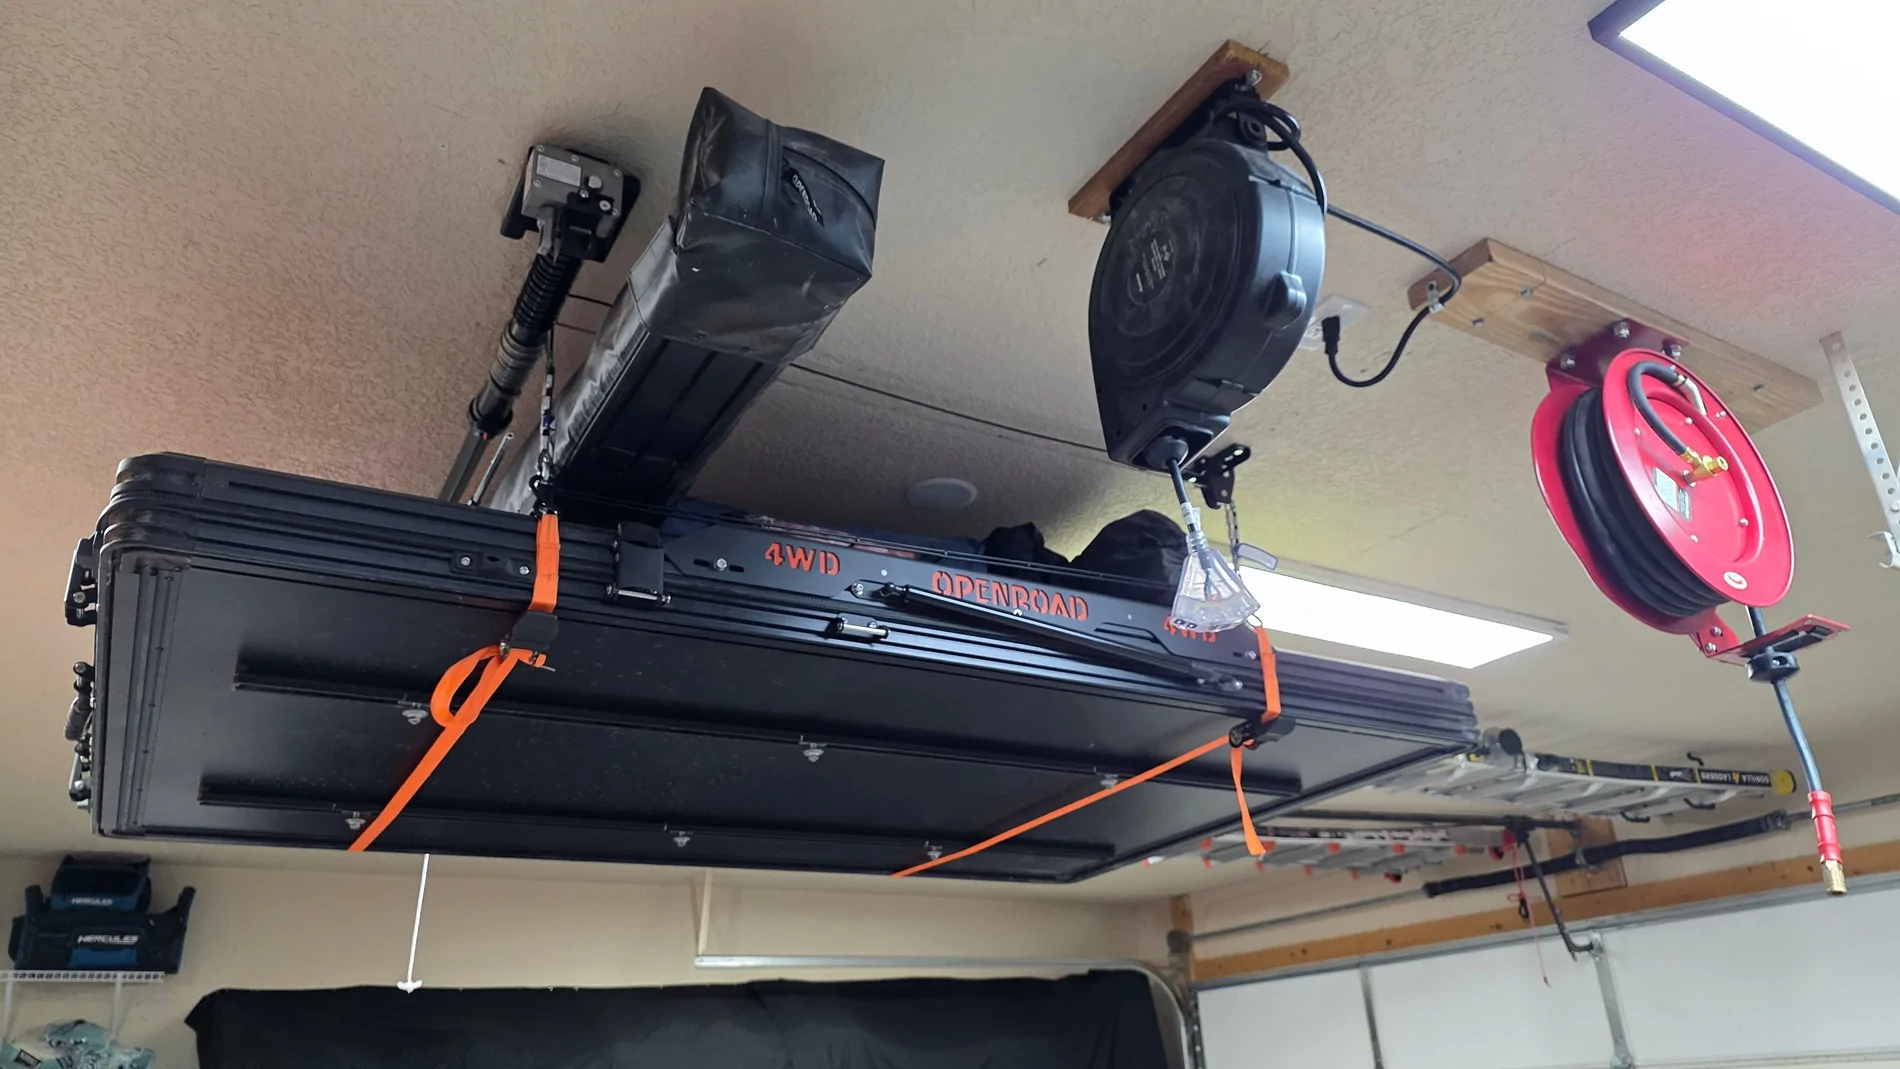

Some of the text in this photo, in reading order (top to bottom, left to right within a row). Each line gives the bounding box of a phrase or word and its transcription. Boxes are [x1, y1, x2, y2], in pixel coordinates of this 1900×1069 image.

[764, 542, 841, 576] 4WD
[932, 571, 1090, 622] OPENROAD
[77, 935, 139, 945] HERCULES
